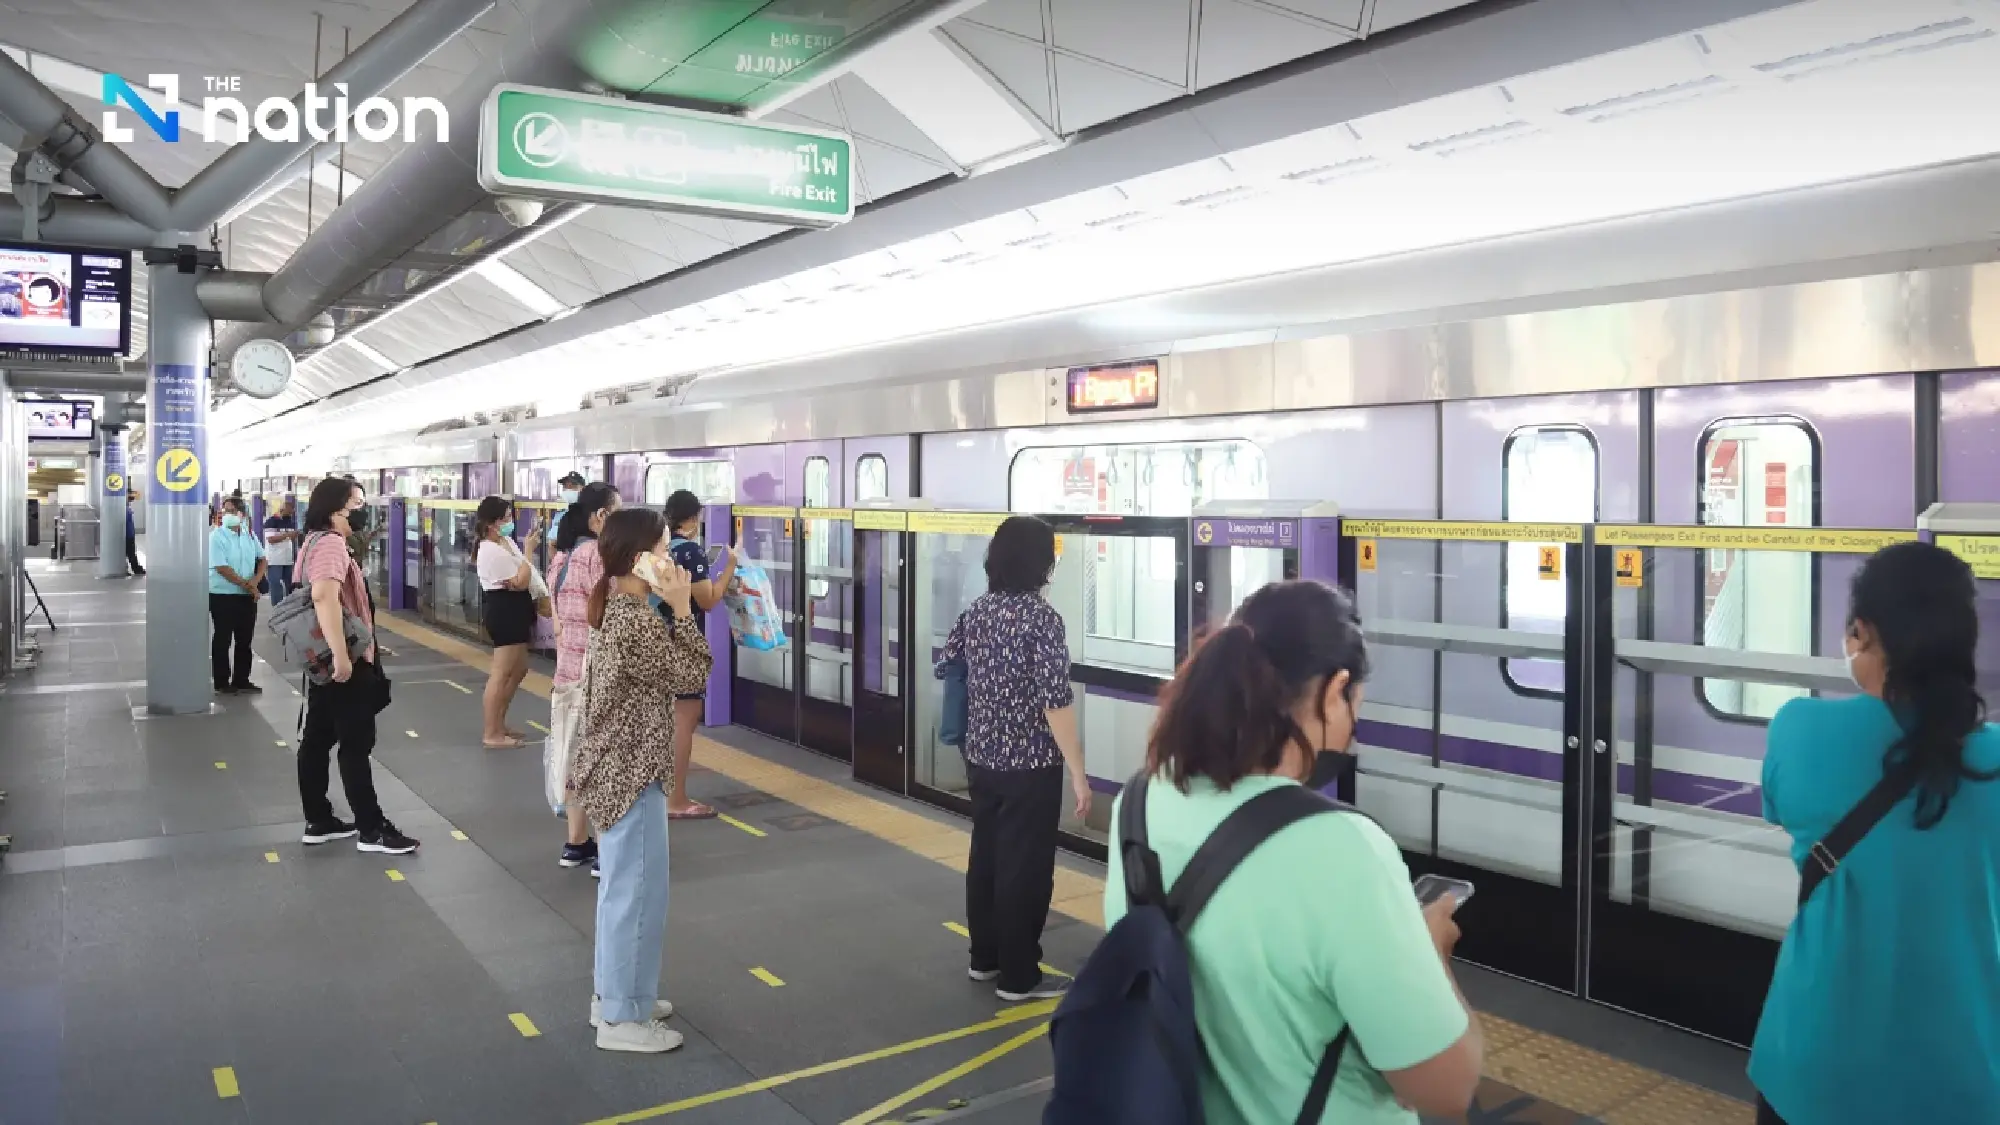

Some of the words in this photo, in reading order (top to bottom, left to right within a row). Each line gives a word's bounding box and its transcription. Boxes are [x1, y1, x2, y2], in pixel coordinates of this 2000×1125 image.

[768, 182, 802, 198] Fire
[805, 184, 837, 203] Exit
[1604, 529, 1618, 540] Let
[1621, 530, 1675, 543] Passengers
[1678, 531, 1696, 542] Exit
[1700, 531, 1721, 543] First
[1724, 533, 1743, 544] and
[1747, 533, 1759, 544] be
[1763, 533, 1800, 545] Careful
[1805, 535, 1815, 546] of
[1819, 535, 1836, 546] the
[1840, 536, 1883, 548] Closing
